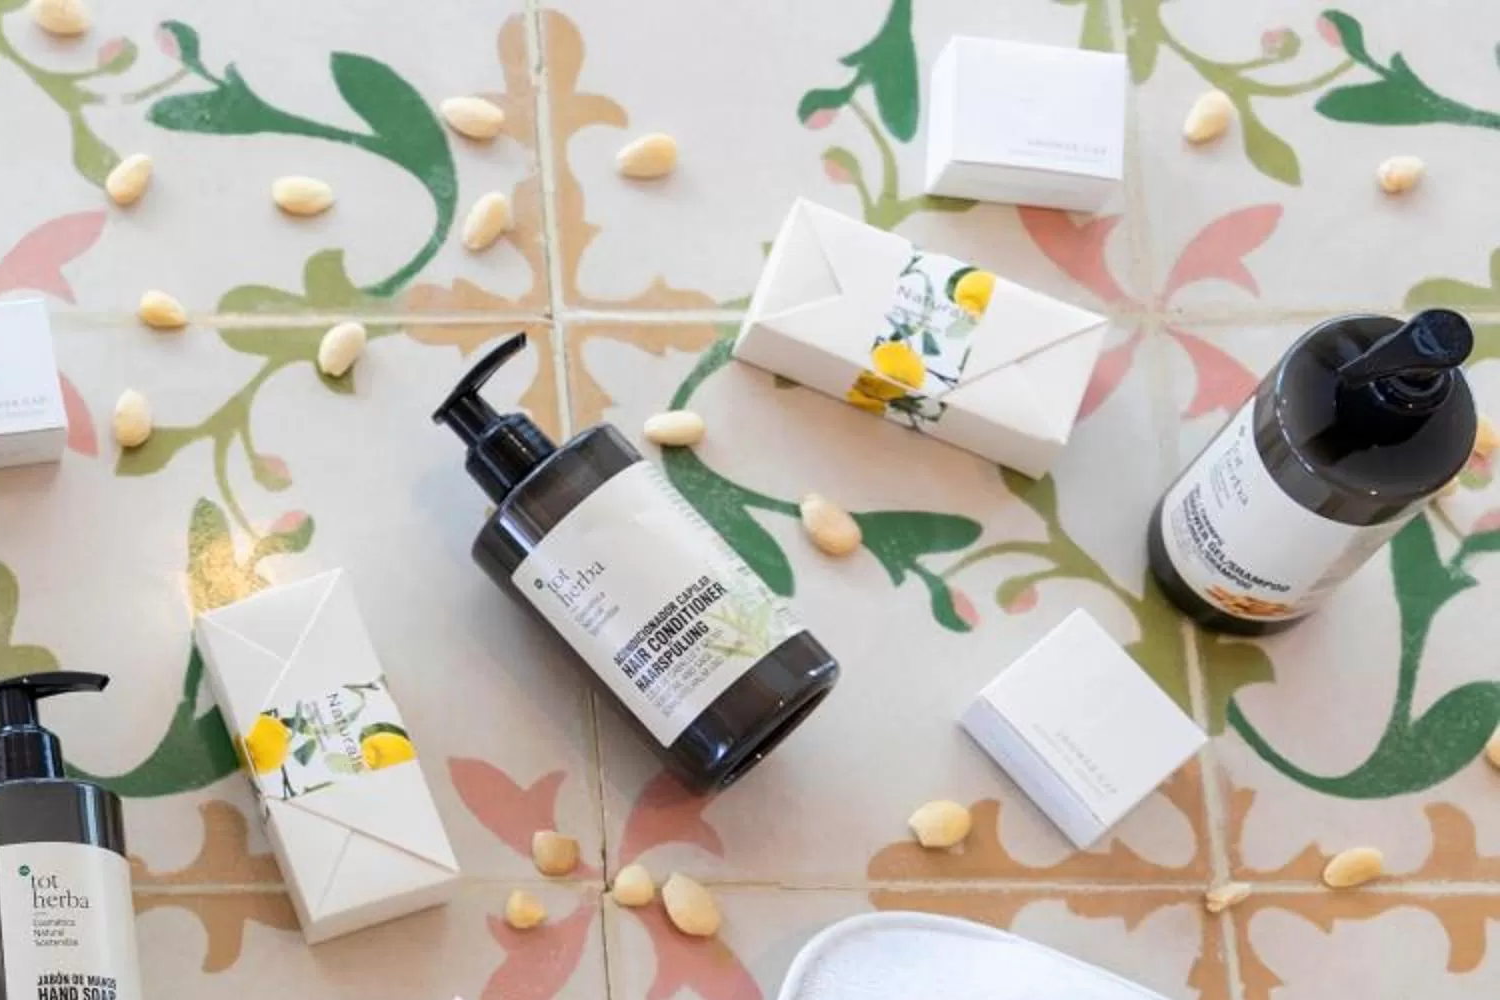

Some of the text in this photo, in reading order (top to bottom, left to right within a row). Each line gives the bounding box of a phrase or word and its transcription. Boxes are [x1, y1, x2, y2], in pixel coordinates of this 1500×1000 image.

[620, 645, 651, 678] HAIR
[647, 581, 726, 651] CONDITIONER
[31, 875, 58, 889] tot
[33, 891, 90, 909] herba
